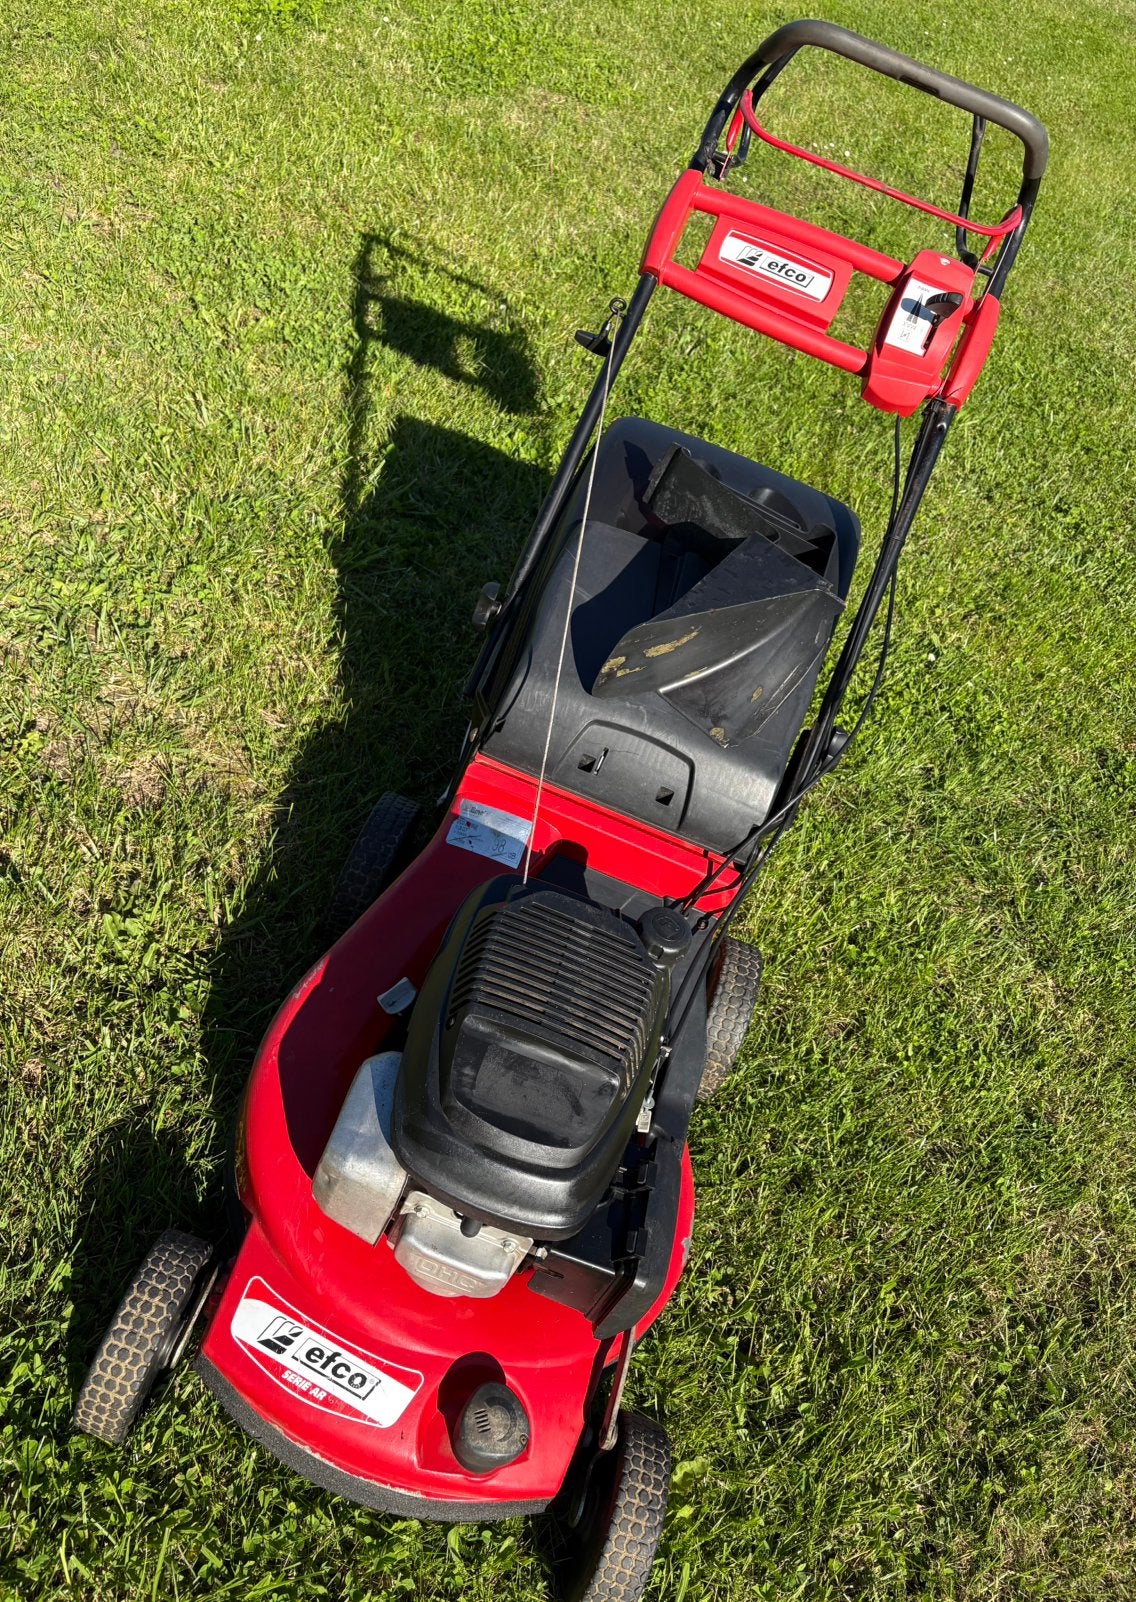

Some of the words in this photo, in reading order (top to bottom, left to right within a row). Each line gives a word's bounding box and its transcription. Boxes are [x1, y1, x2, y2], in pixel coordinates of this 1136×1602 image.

[767, 261, 807, 283] efco
[305, 1346, 368, 1390] efco
[281, 1370, 314, 1392] SERIE
[308, 1386, 328, 1401] AR
